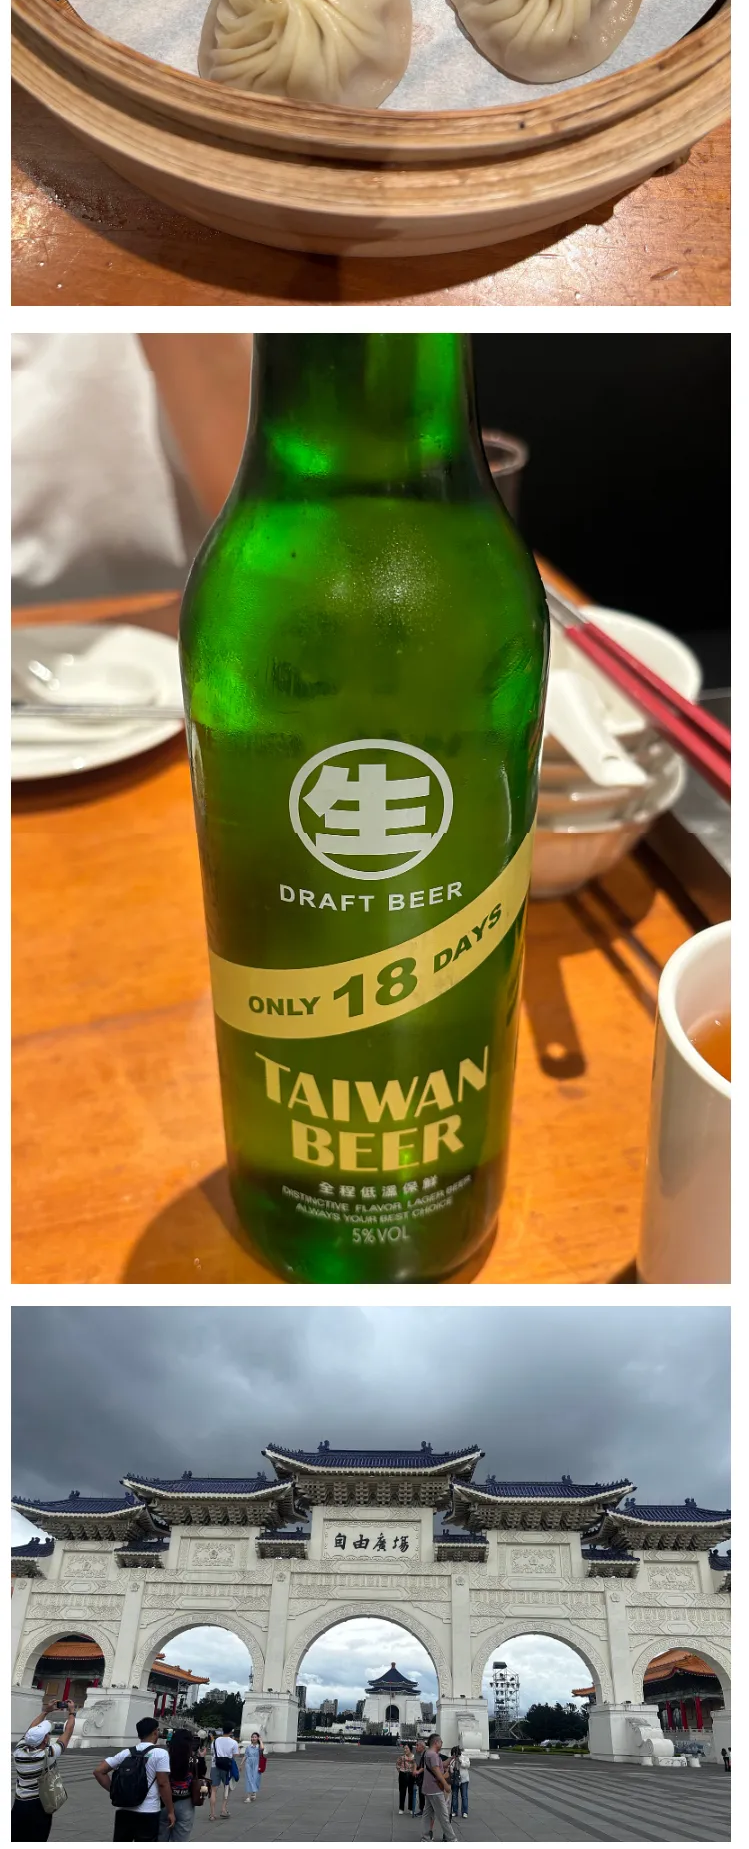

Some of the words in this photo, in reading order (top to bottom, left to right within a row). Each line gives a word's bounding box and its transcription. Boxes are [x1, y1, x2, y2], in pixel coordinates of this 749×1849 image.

[303, 764, 430, 855] 生
[280, 883, 375, 912] DRAFT
[388, 881, 463, 911] BEER
[248, 996, 320, 1016] ONLY
[333, 957, 418, 1018] 18
[433, 902, 502, 973] DAYS
[255, 1045, 489, 1123] TAIWAN
[292, 1114, 464, 1172] BEER
[281, 1184, 349, 1213] DISTINCTIVE
[355, 1201, 402, 1214] FLAVOR
[407, 1189, 445, 1208] LAGER
[446, 1174, 472, 1194] BEER
[295, 1202, 341, 1222] ALWAYS
[344, 1213, 378, 1224] YOUR
[379, 1210, 410, 1224] BEST
[412, 1197, 453, 1218] CHOICE
